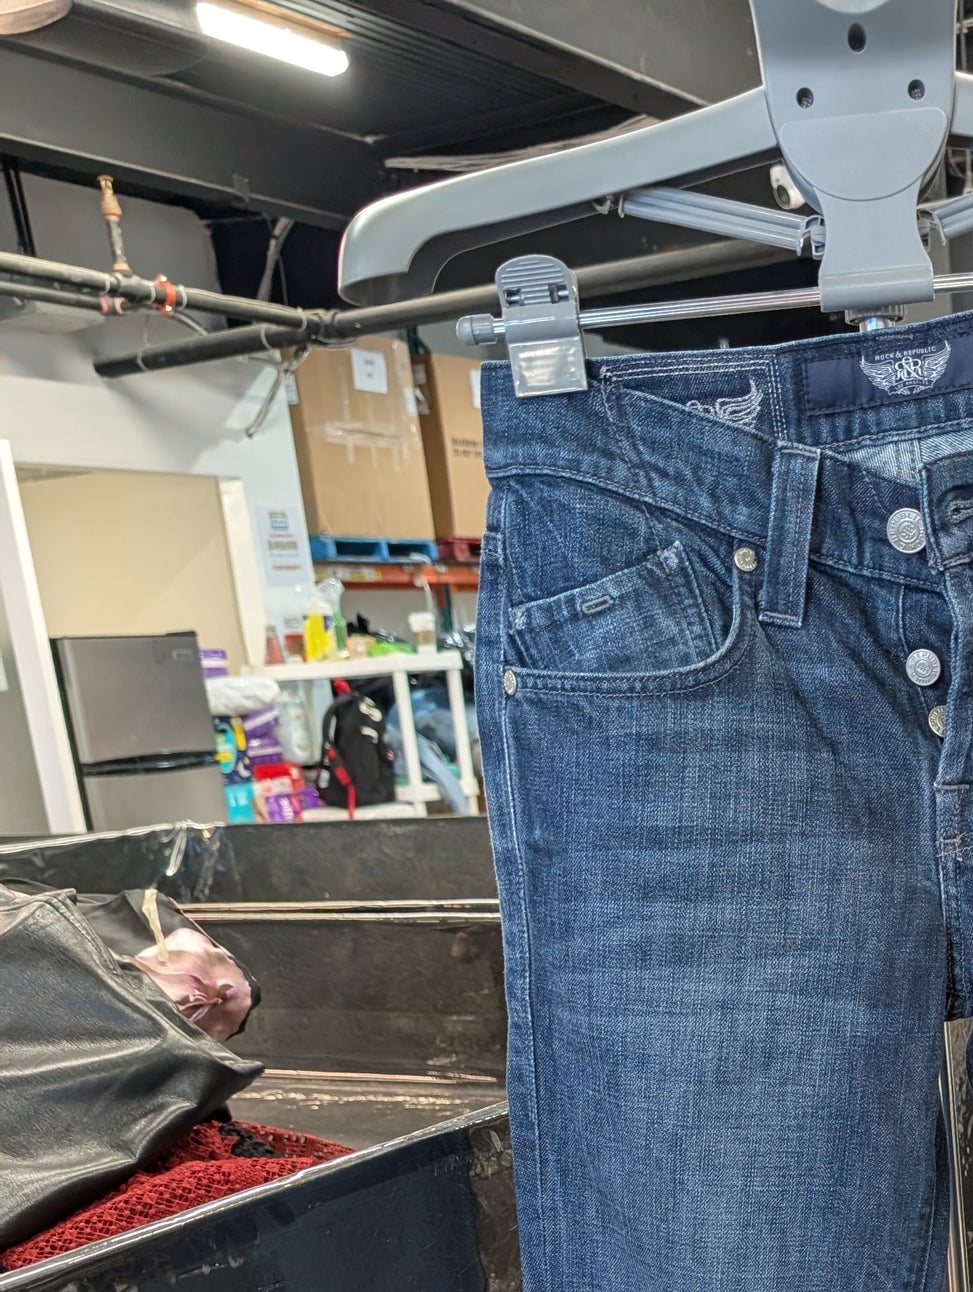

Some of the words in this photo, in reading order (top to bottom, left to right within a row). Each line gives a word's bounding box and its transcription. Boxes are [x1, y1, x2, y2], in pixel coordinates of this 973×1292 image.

[874, 351, 895, 361] ROCK
[895, 350, 902, 359] &
[903, 346, 937, 357] REPUBLIC
